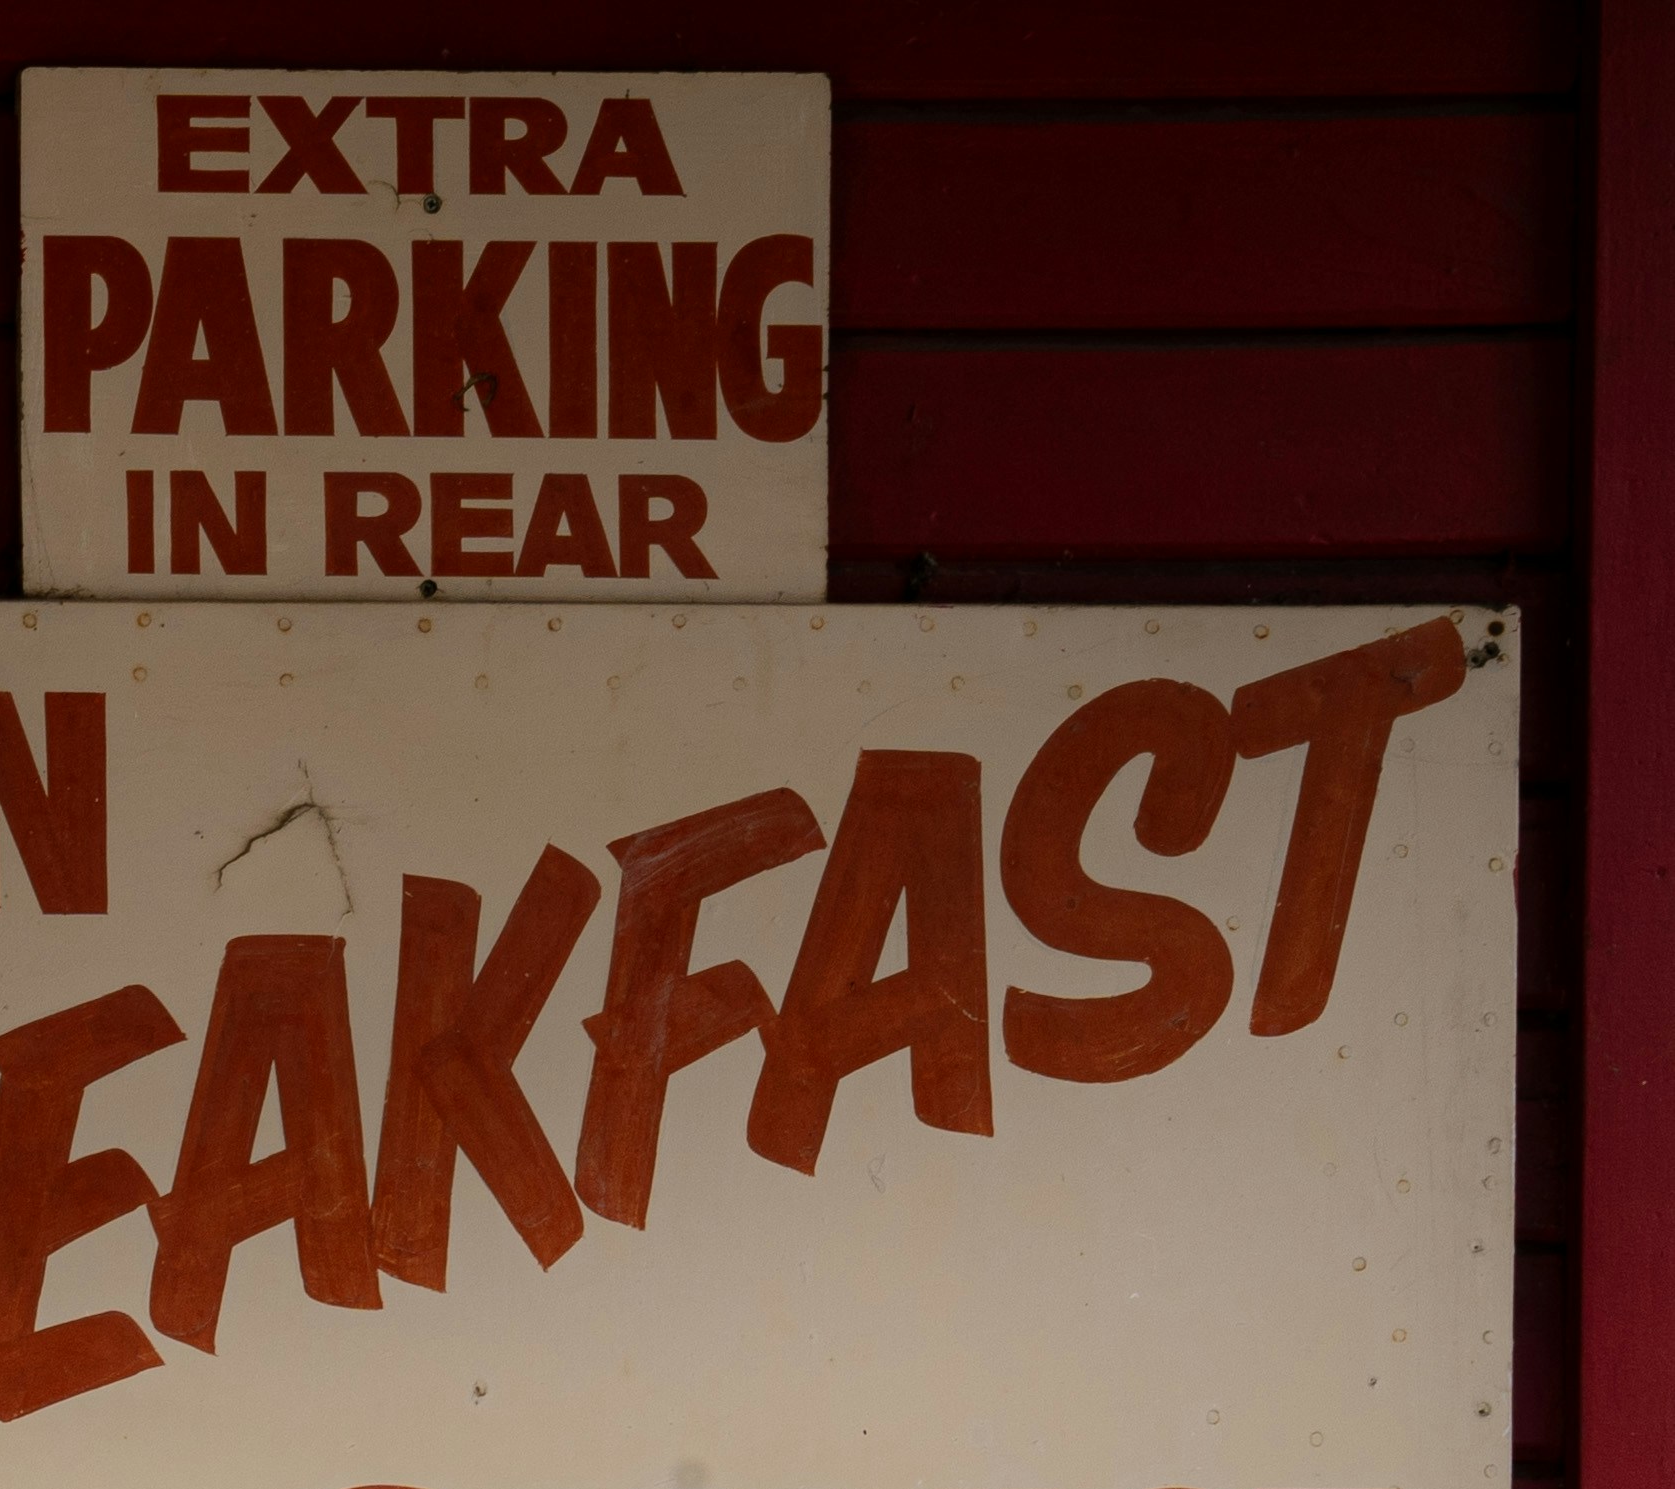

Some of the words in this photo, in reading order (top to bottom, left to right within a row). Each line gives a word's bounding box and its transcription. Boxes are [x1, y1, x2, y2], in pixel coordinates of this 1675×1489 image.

[157, 94, 687, 198] EXTRA
[42, 234, 824, 444] PARKING
[126, 469, 268, 576] IN
[323, 471, 720, 580] REAR
